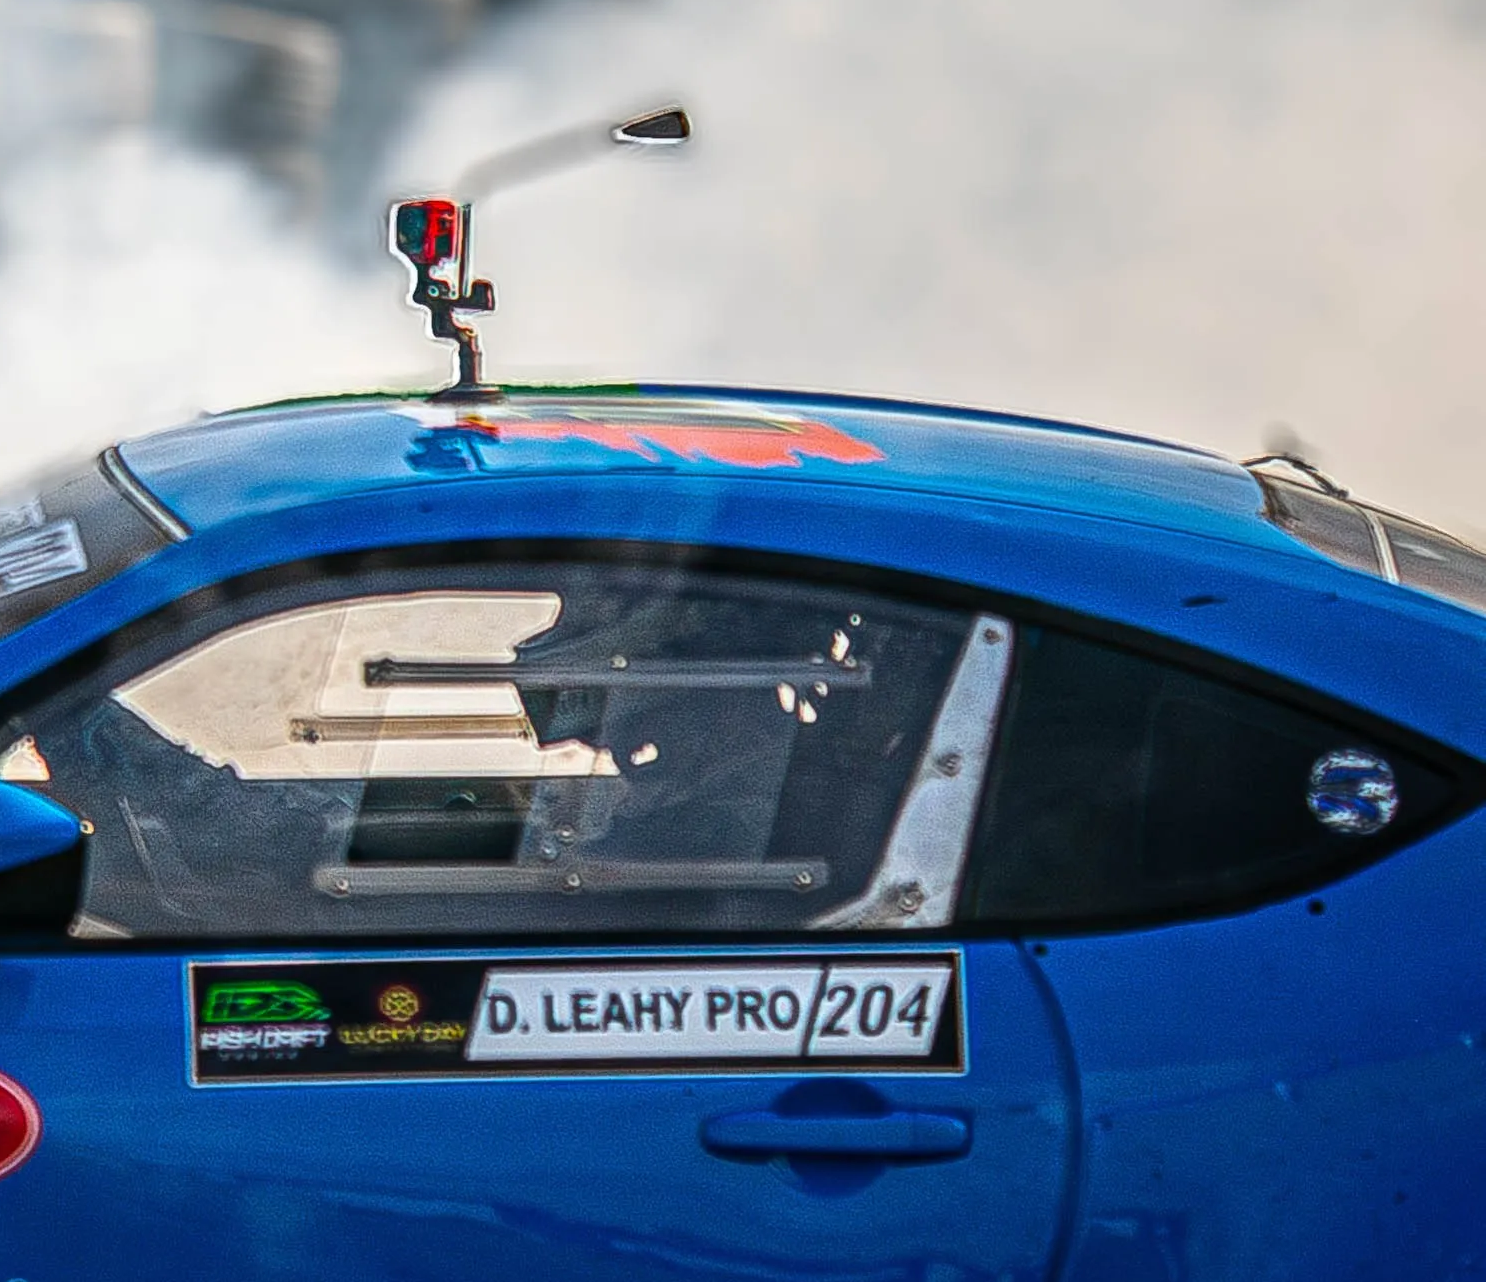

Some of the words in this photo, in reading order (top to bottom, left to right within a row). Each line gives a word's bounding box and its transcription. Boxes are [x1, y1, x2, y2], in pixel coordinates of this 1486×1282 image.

[487, 992, 530, 1035] D.
[543, 987, 690, 1033] LEAHY
[706, 988, 801, 1032] PRO
[819, 984, 932, 1038] 204
